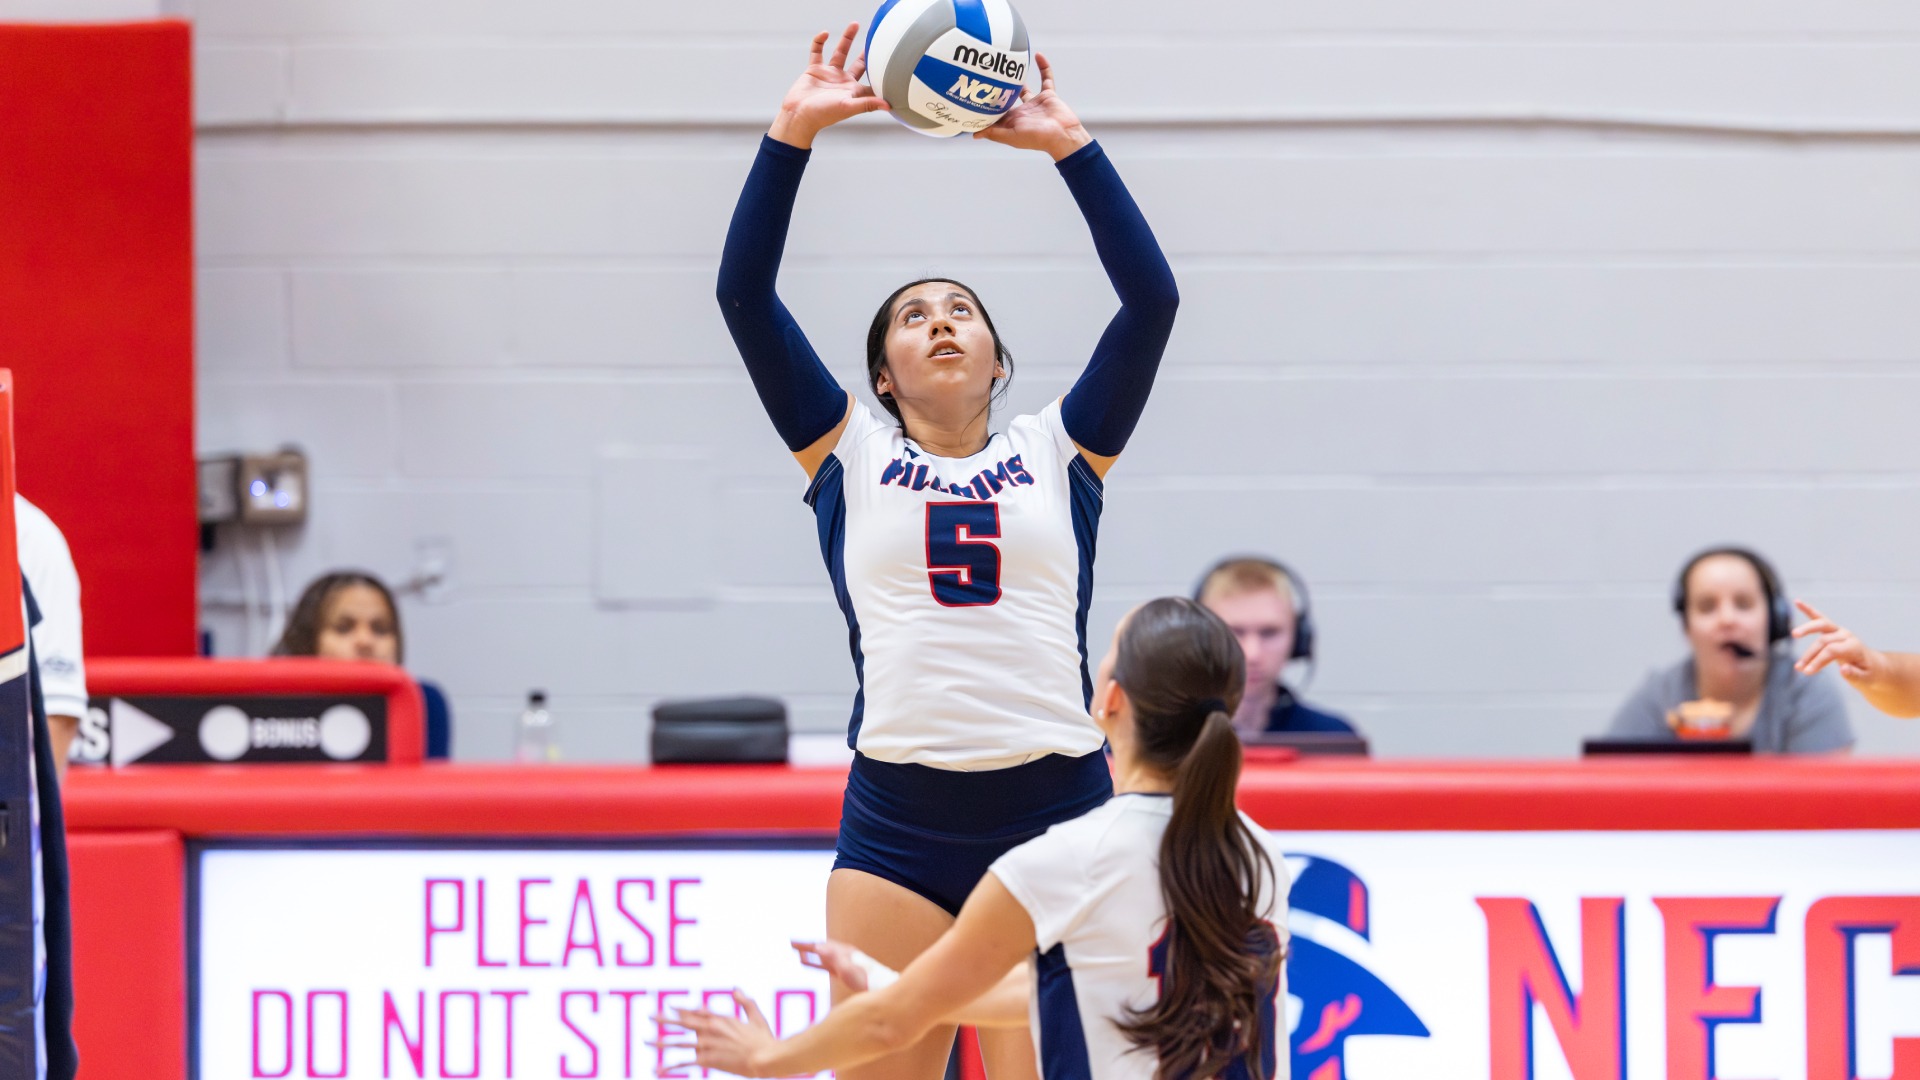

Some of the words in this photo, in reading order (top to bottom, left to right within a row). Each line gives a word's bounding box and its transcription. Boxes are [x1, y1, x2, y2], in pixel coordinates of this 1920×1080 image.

[949, 73, 1012, 109] NCAA
[953, 44, 1025, 81] molten
[925, 501, 1002, 608] 5
[252, 717, 320, 749] BONUS
[423, 876, 703, 968] PLEASE
[250, 988, 349, 1080] DO
[382, 988, 530, 1080] NOT
